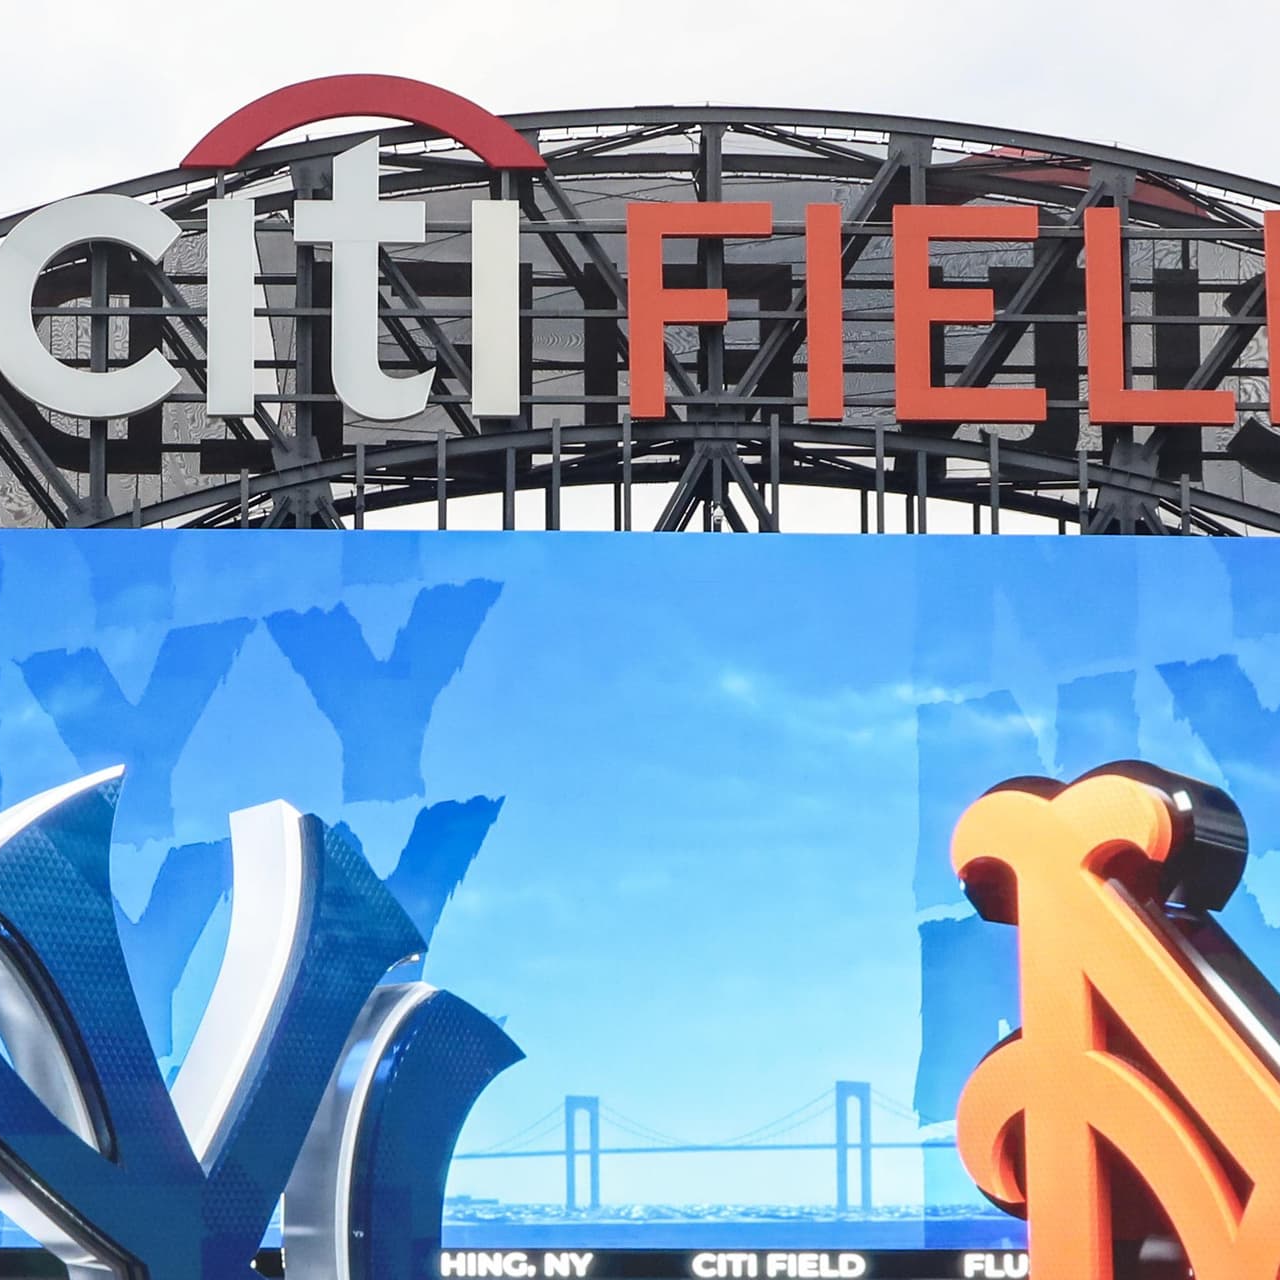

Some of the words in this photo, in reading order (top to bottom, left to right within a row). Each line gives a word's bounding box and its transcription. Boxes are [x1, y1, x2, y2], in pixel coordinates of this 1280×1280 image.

[545, 1252, 595, 1278] NY
[691, 1252, 760, 1279] CITI
[767, 1252, 866, 1279] FIELD
